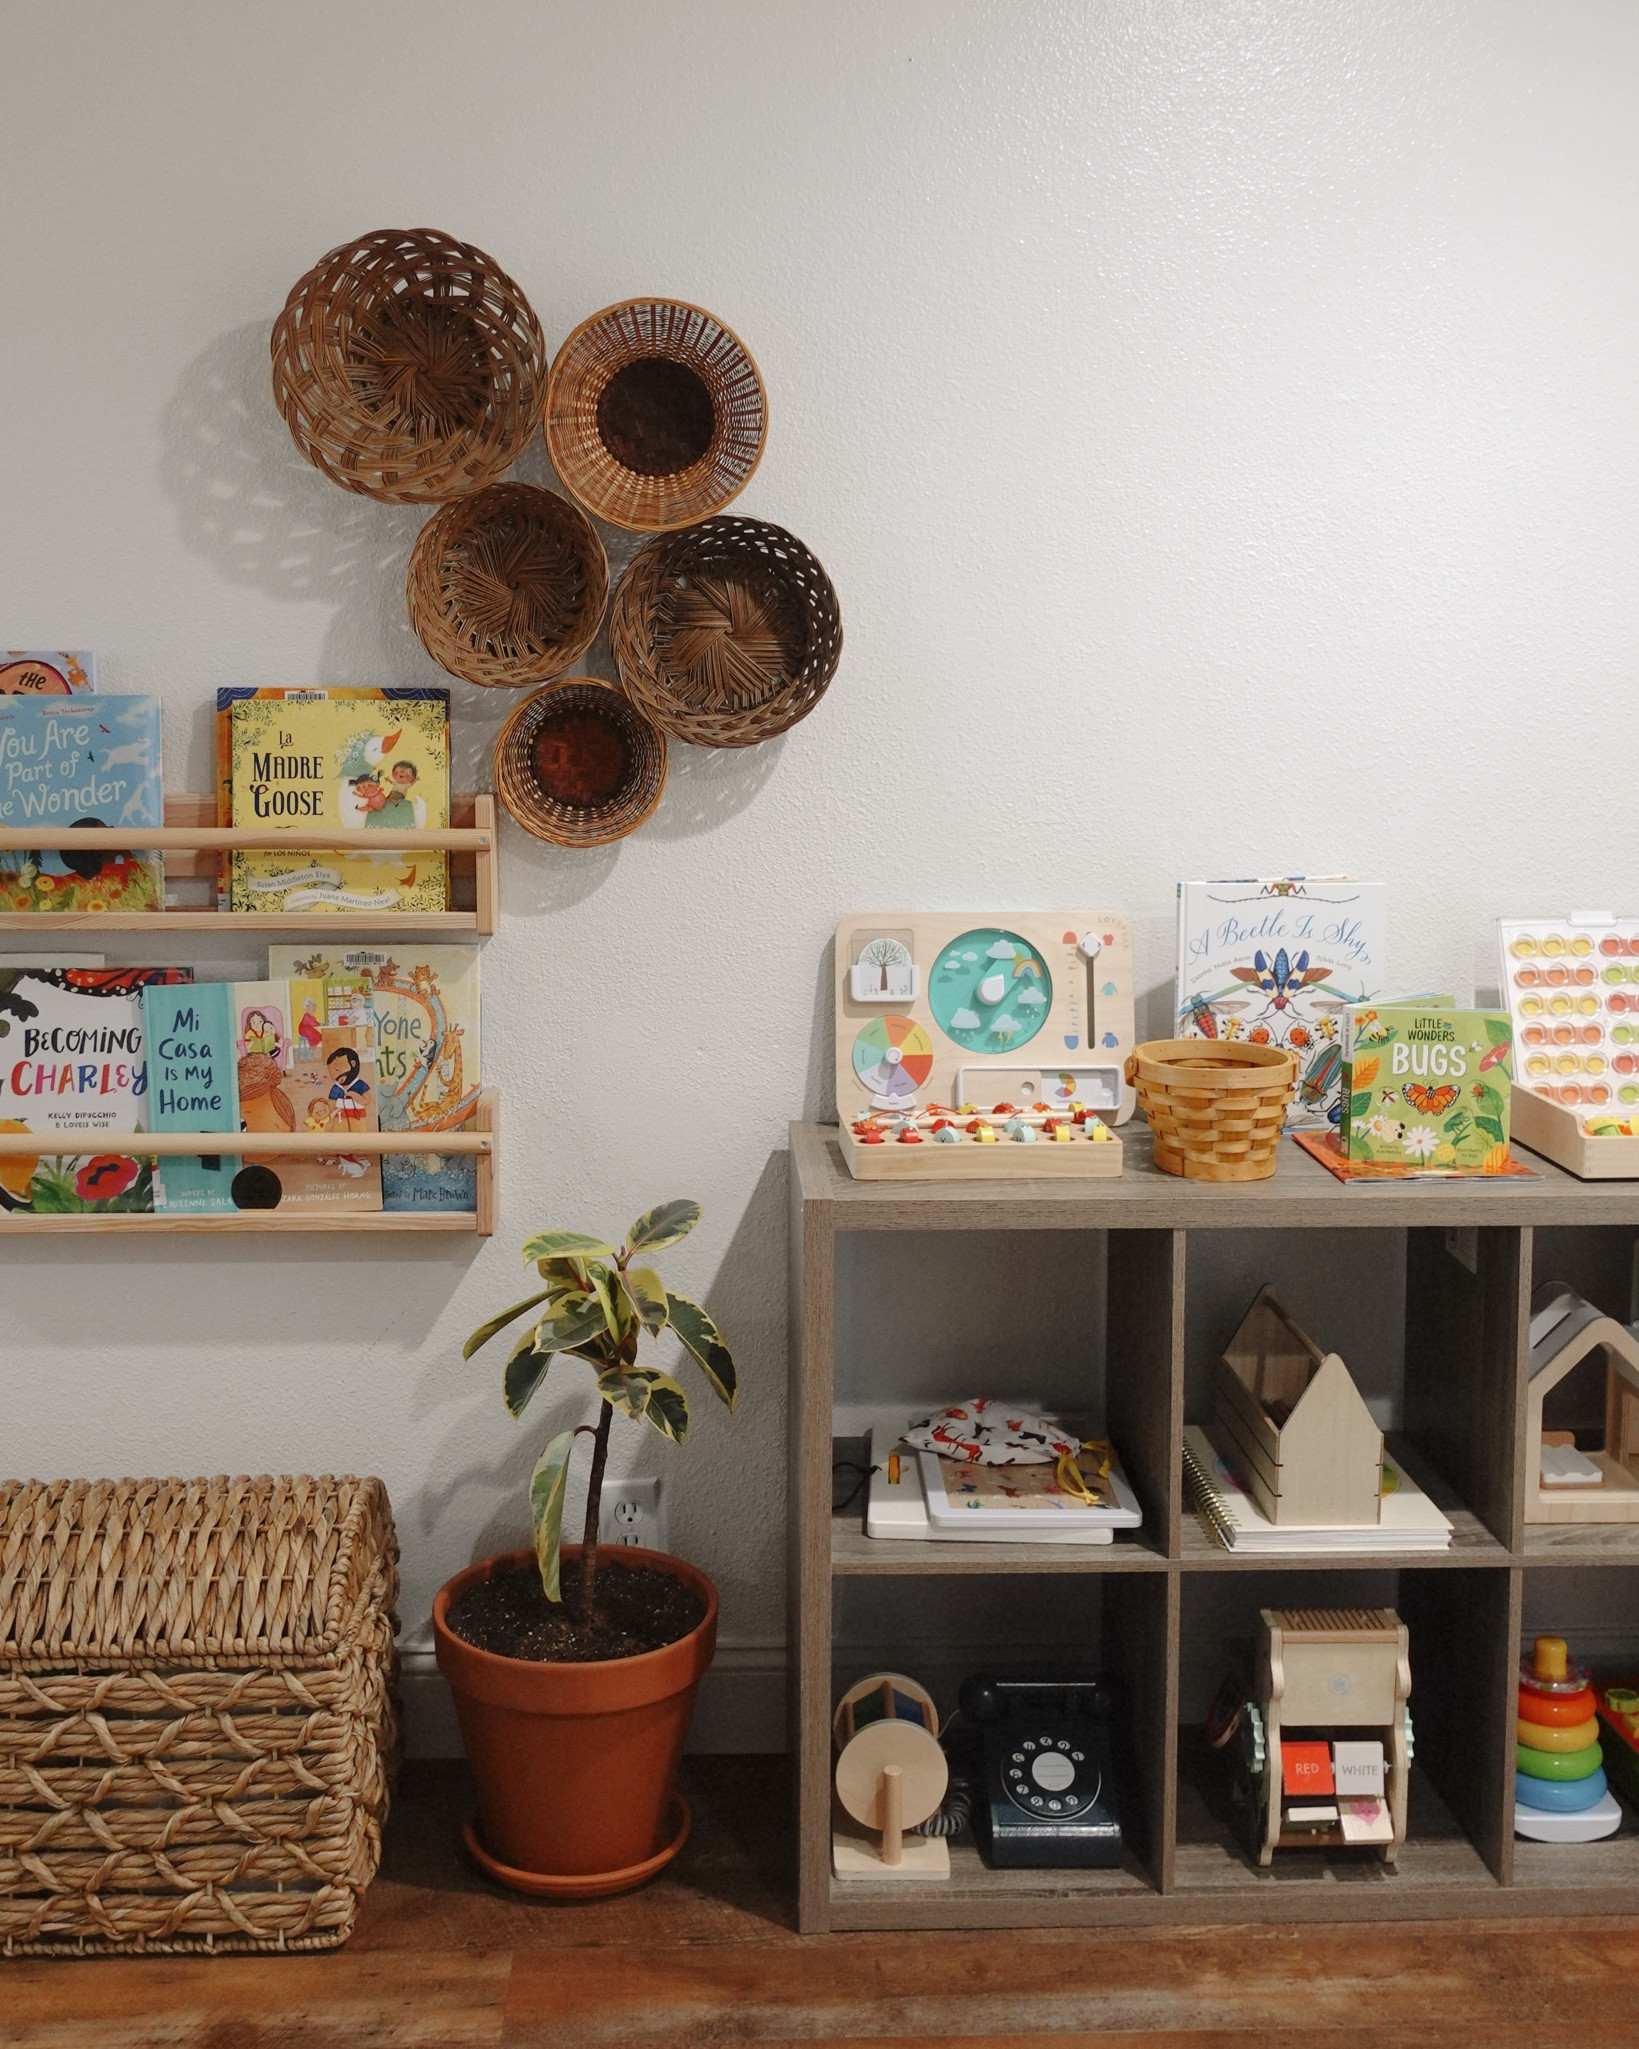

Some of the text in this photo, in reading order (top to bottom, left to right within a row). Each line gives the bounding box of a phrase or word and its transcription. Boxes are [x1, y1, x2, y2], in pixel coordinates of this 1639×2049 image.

[38, 719, 90, 761] Are
[279, 730, 294, 750] La
[5, 750, 81, 791] Part of
[252, 752, 324, 783] MADRE
[12, 774, 127, 819] Wonder
[249, 783, 324, 819] GOOSE
[277, 872, 314, 887] Middleton
[315, 870, 331, 879] Elya
[319, 893, 340, 901] Juana
[1189, 908, 1371, 966] A Beetle Is Shy
[173, 1007, 199, 1033] Mi
[1414, 1017, 1442, 1030] LITTLE
[1407, 1029, 1455, 1042] WONDERS
[159, 1037, 213, 1060] Casa
[1391, 1042, 1467, 1078] BUGS
[10, 1060, 149, 1097] CHARLEY
[185, 1066, 213, 1089] My
[159, 1088, 222, 1114] Home
[1341, 1087, 1350, 1114] BUGS
[55, 1121, 60, 1129] &
[63, 1121, 90, 1129] LOVEIS
[181, 1189, 205, 1197] WORDS
[281, 1191, 372, 1203] ZARA GONZÁLEZ HOANG
[305, 1183, 335, 1191] PICTURES
[411, 1186, 438, 1202] Marc
[439, 1187, 469, 1202] Brown
[210, 1197, 233, 1208] SALA
[1295, 1762, 1320, 1775] RED
[1342, 1765, 1379, 1776] WHITE
